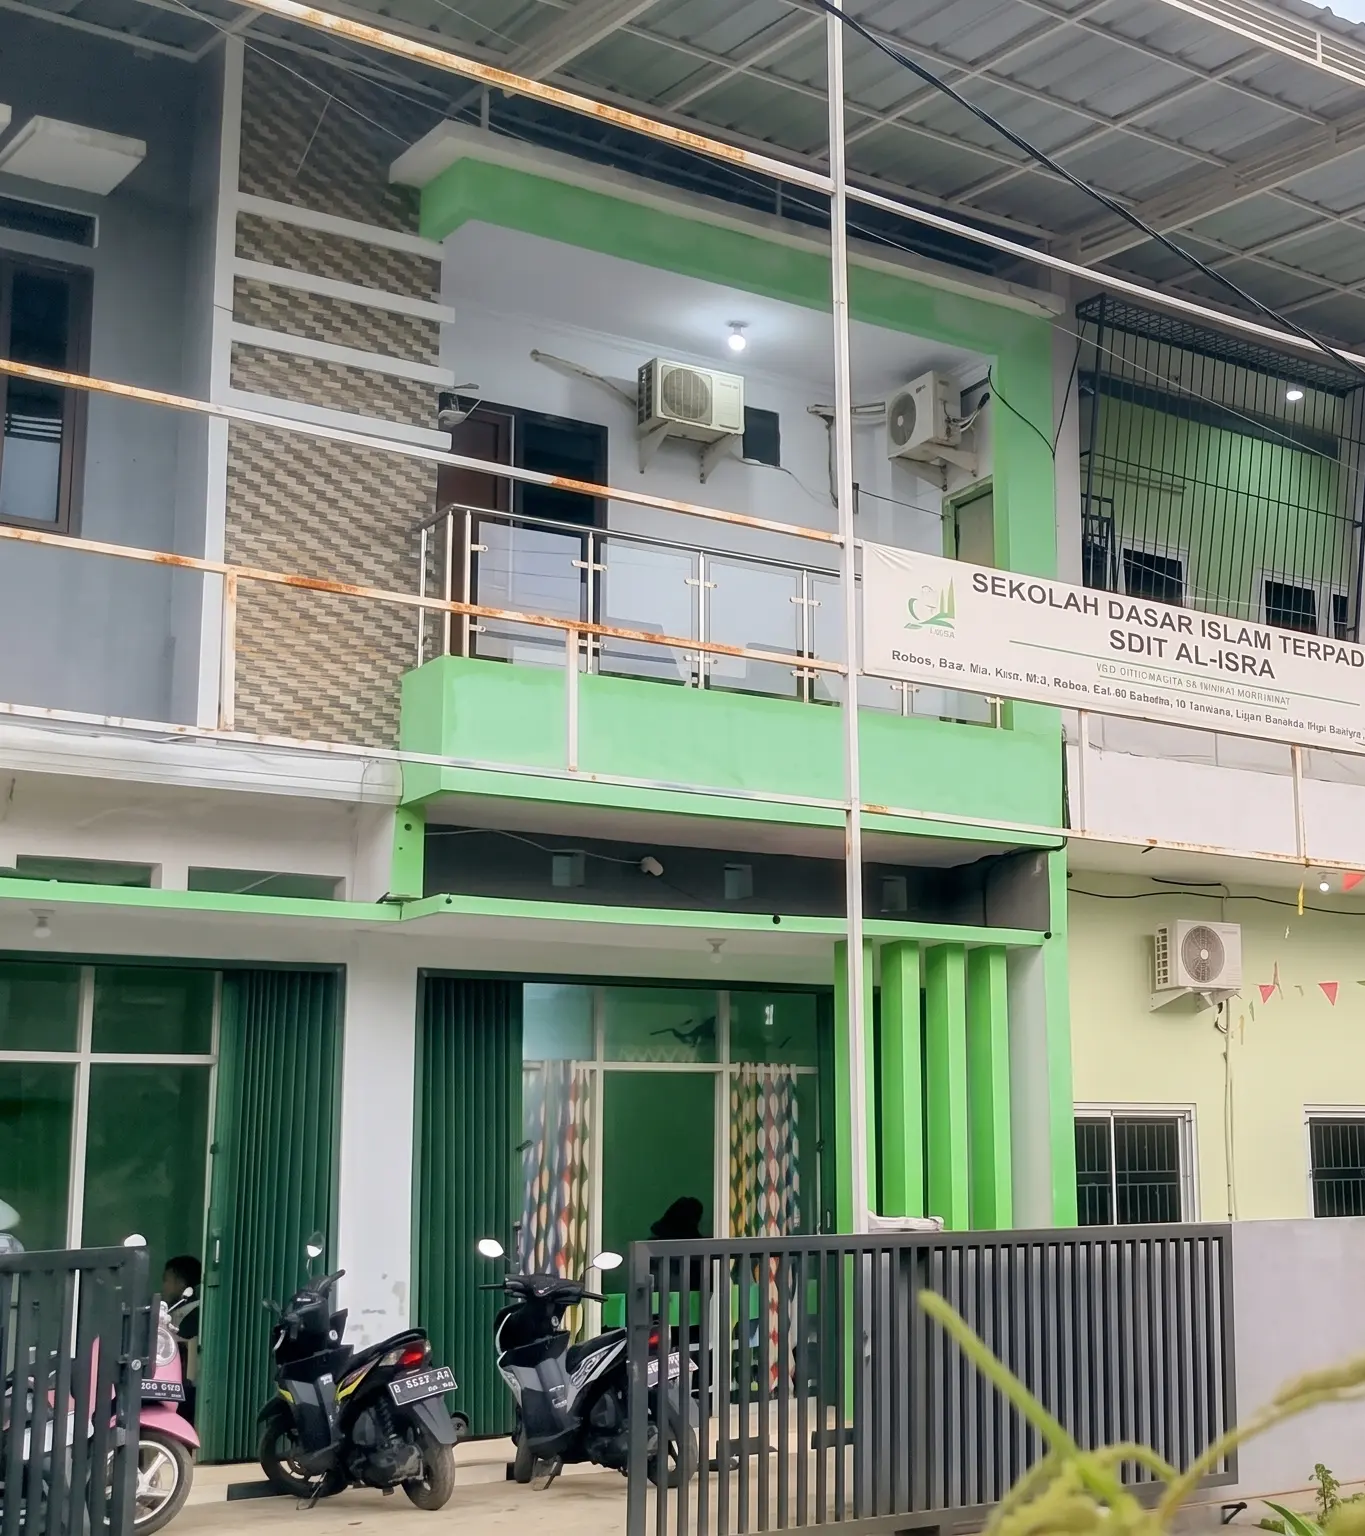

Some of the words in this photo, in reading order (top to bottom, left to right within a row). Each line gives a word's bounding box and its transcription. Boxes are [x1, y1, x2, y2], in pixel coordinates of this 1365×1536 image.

[972, 573, 1099, 616] SEKOLAH
[1108, 600, 1194, 636] DASAR
[1201, 619, 1271, 651] ISLAM
[892, 650, 935, 668] Robos,
[1109, 629, 1168, 658] SDIT
[1175, 643, 1276, 679] AL-ISRA
